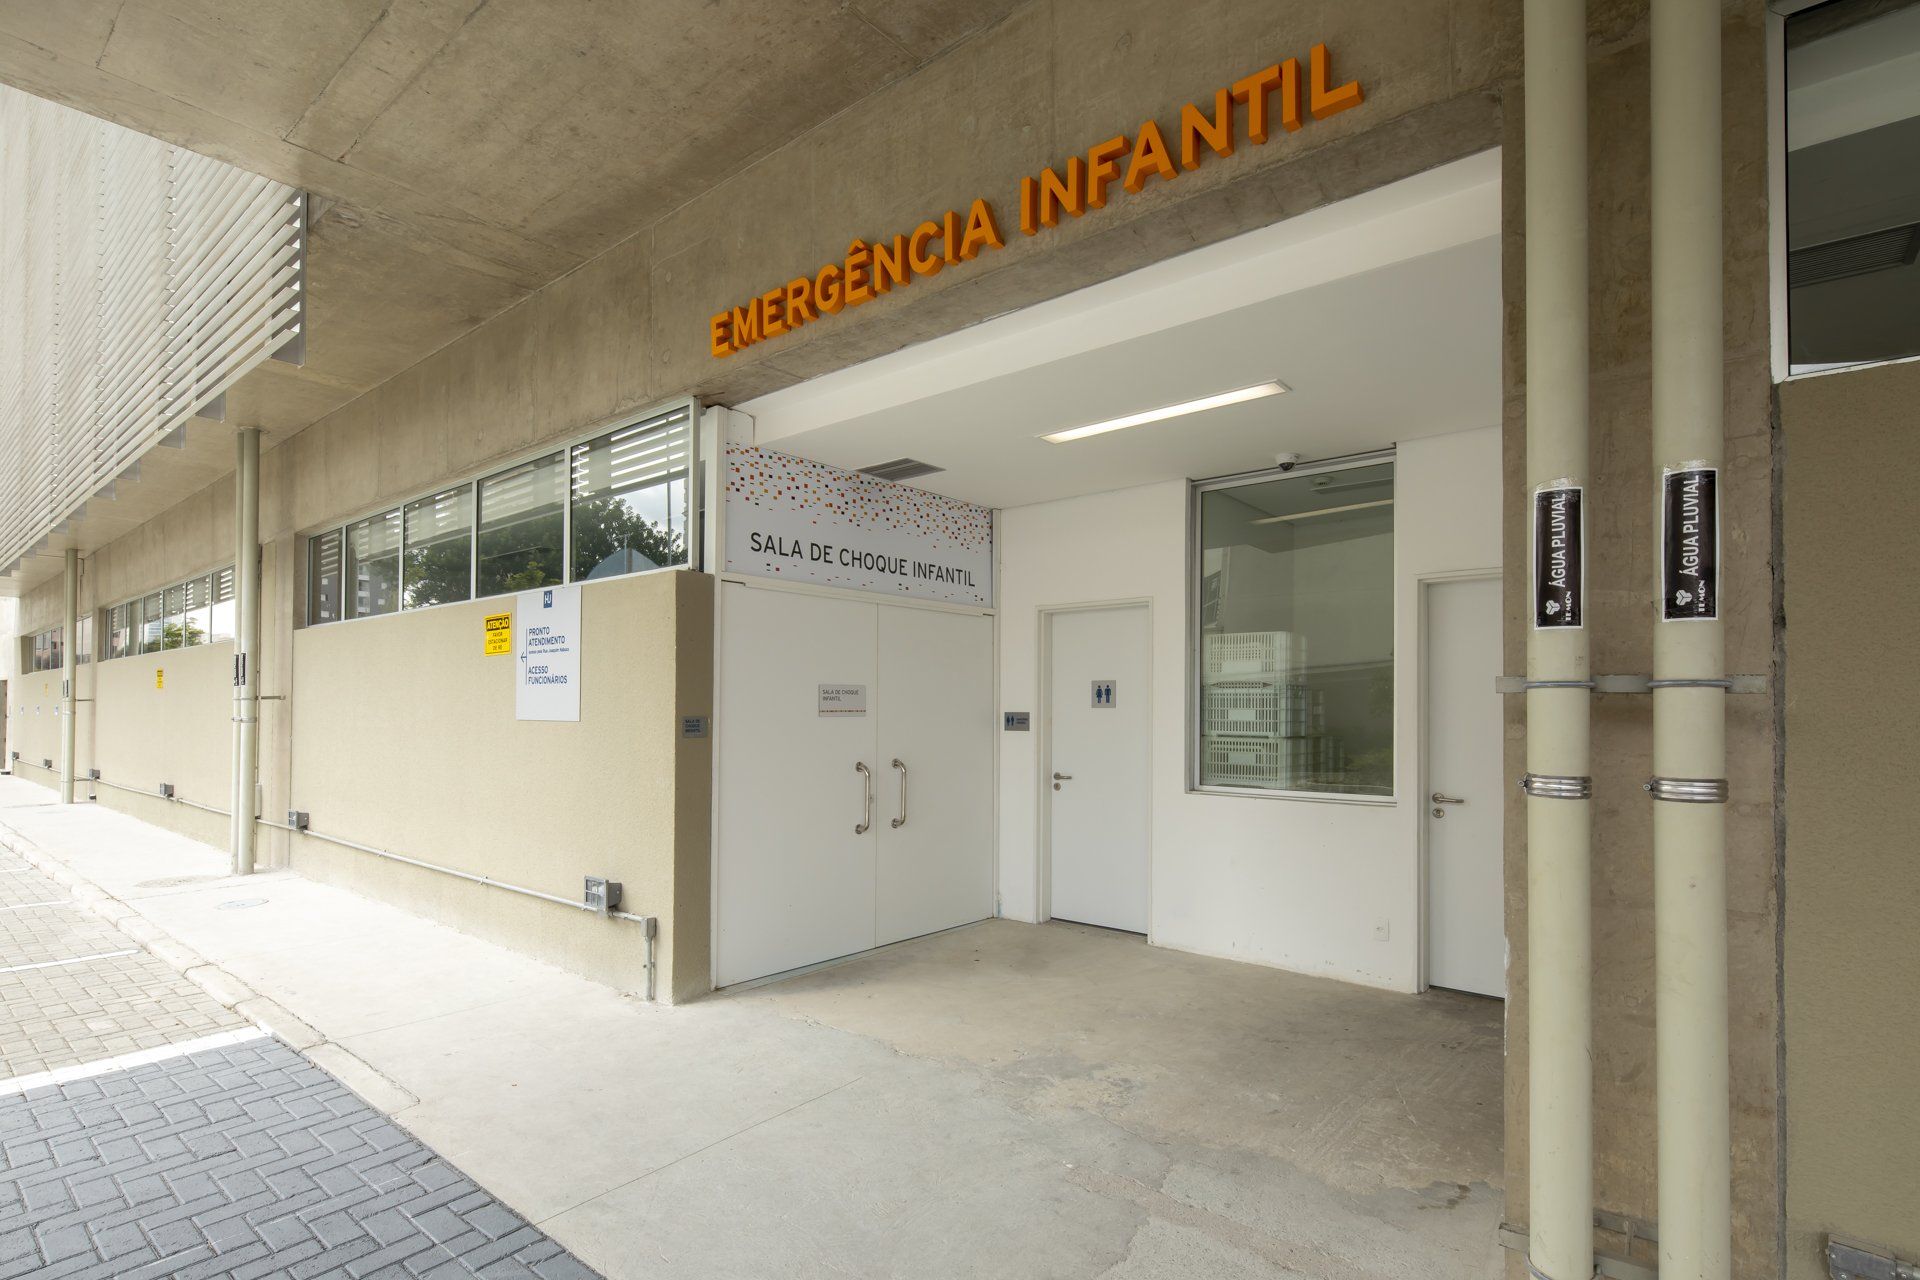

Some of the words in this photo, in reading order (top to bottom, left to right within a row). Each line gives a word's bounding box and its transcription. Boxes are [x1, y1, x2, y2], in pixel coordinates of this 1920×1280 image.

[710, 198, 1005, 358] EMERGÊNCIA
[1020, 43, 1364, 236] INFANTIL
[1552, 493, 1567, 549] PLUVIAL
[1683, 475, 1699, 535] PLUVIAL
[750, 532, 803, 559] SALA
[810, 543, 833, 564] DE
[839, 548, 908, 576] CHOQUE
[913, 560, 976, 587] INFANTIL
[1548, 550, 1566, 588] ÁGUA
[1679, 537, 1699, 577] ÁGUA
[487, 618, 509, 631] ATENÇÃO
[528, 635, 566, 647] ATENDIMENTO
[529, 627, 550, 636] PRONTO
[528, 666, 549, 675] ACESSO
[528, 674, 568, 685] FUNCIONÁRIOS
